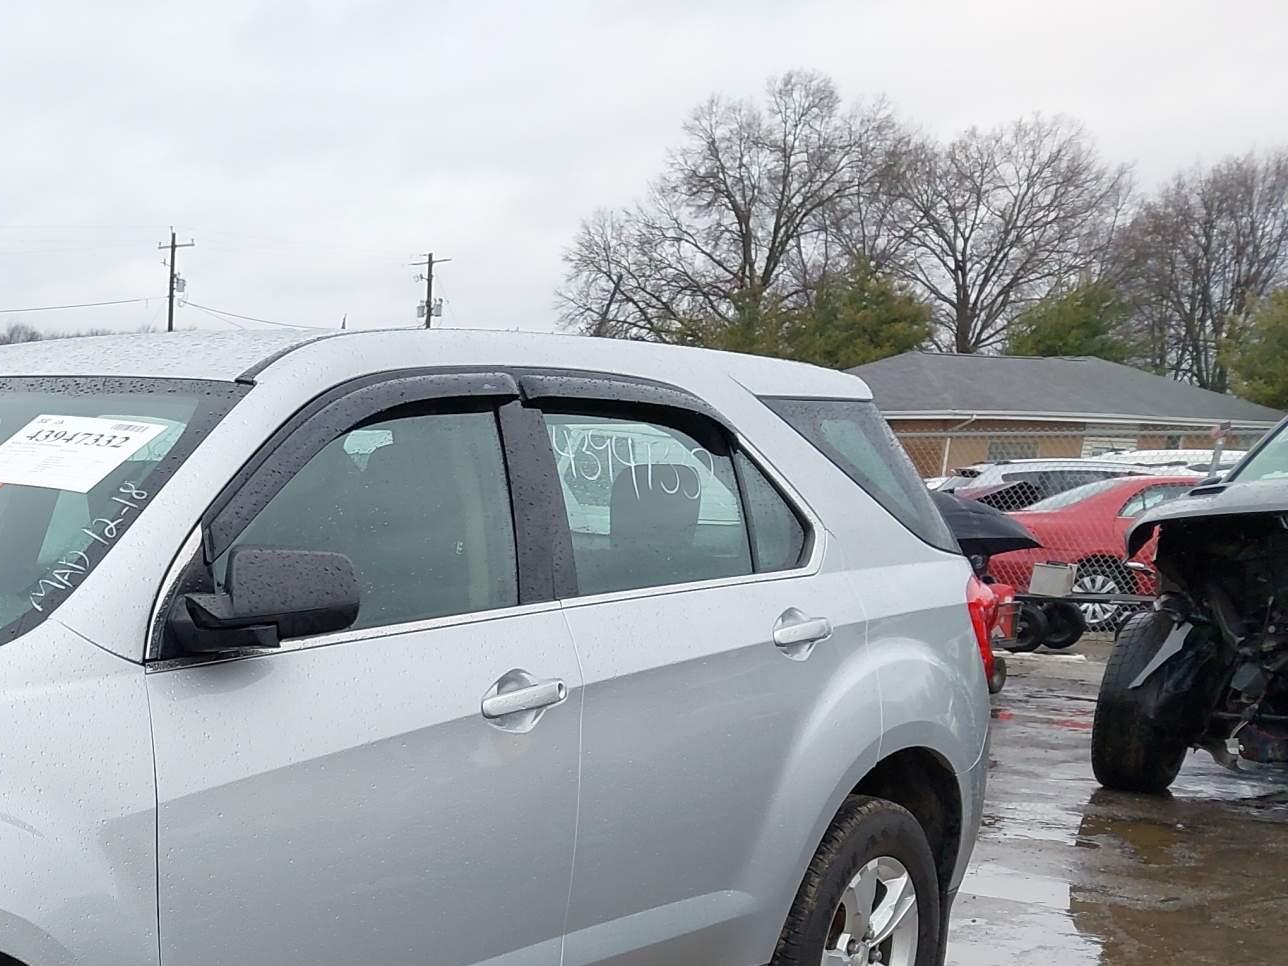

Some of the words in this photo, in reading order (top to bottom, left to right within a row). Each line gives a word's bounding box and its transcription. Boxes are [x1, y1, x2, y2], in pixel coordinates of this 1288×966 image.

[25, 428, 131, 449] 43947332
[30, 550, 89, 612] MAD
[81, 480, 149, 545] 12-18
